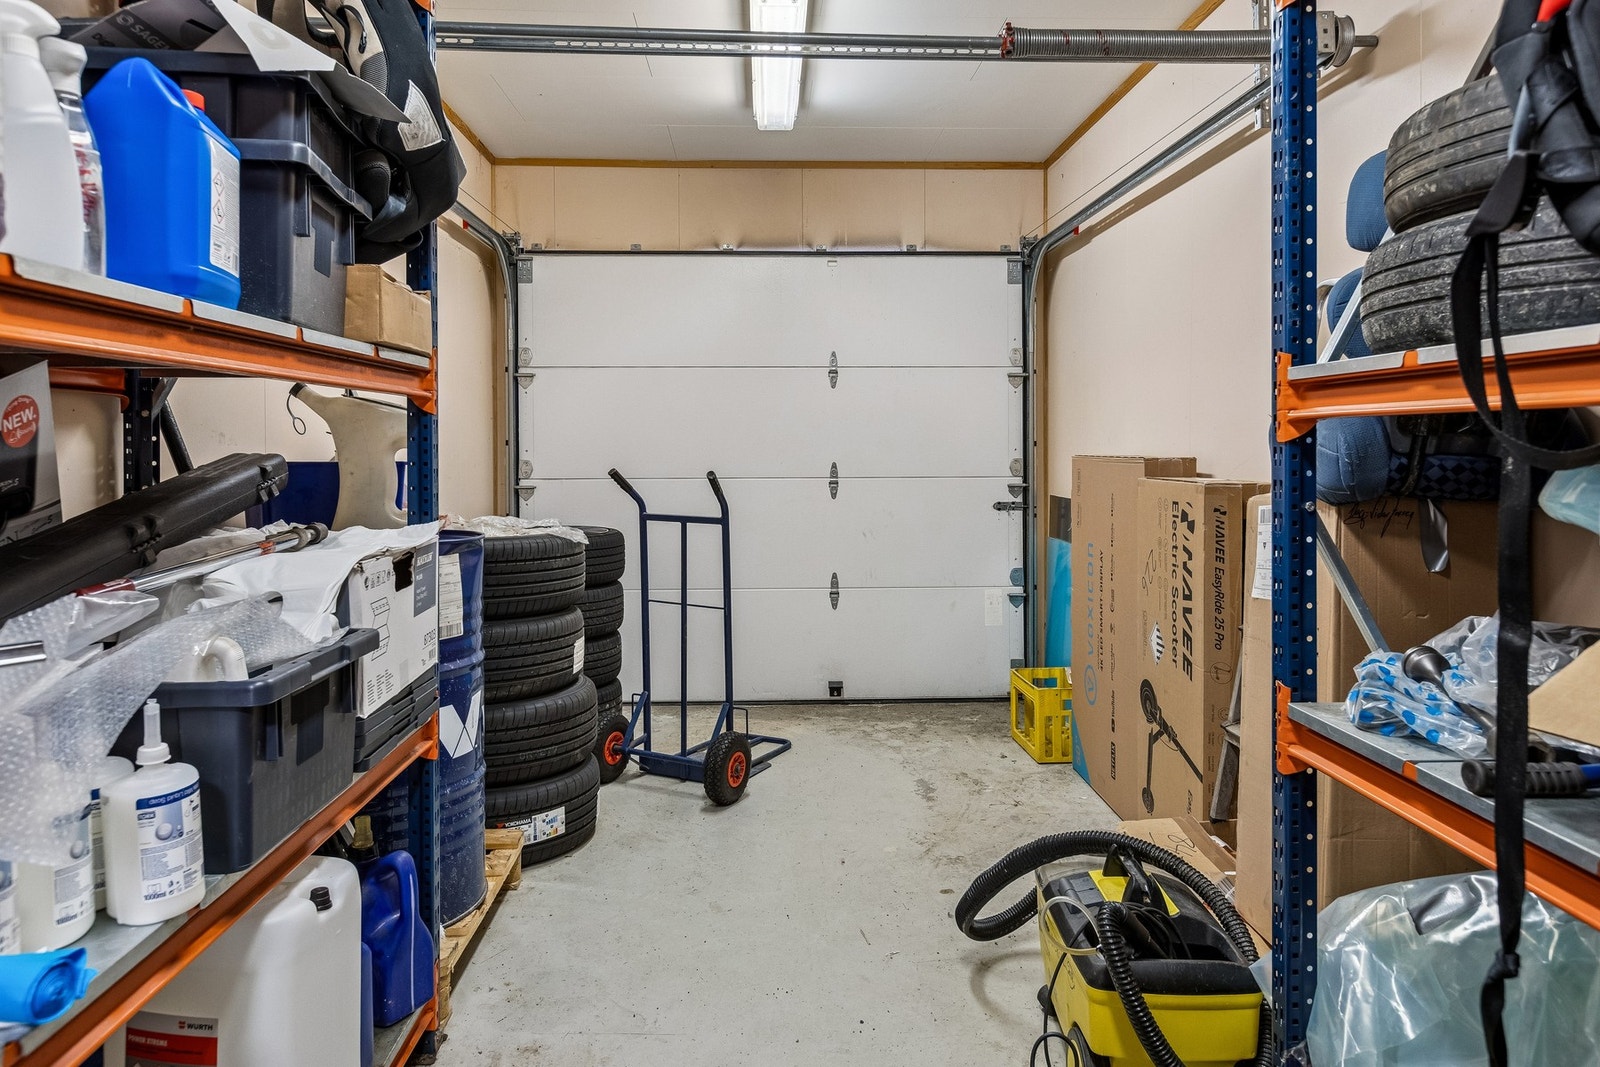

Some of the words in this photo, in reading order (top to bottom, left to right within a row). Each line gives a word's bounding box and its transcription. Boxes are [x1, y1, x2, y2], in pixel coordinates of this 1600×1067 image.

[1171, 501, 1180, 580] Electric
[1215, 519, 1225, 564] NAVEE
[1086, 542, 1094, 657] VOXICON
[1212, 566, 1224, 615] EasyRide
[1171, 585, 1180, 669] Scooter
[1182, 544, 1193, 682] NAVEE
[1214, 616, 1224, 630] 25
[1214, 632, 1224, 651] Pro
[148, 797, 166, 805] Soap
[167, 791, 183, 802] Liquid
[504, 818, 532, 828] YOKOHAMA
[143, 890, 166, 901] 1000ml
